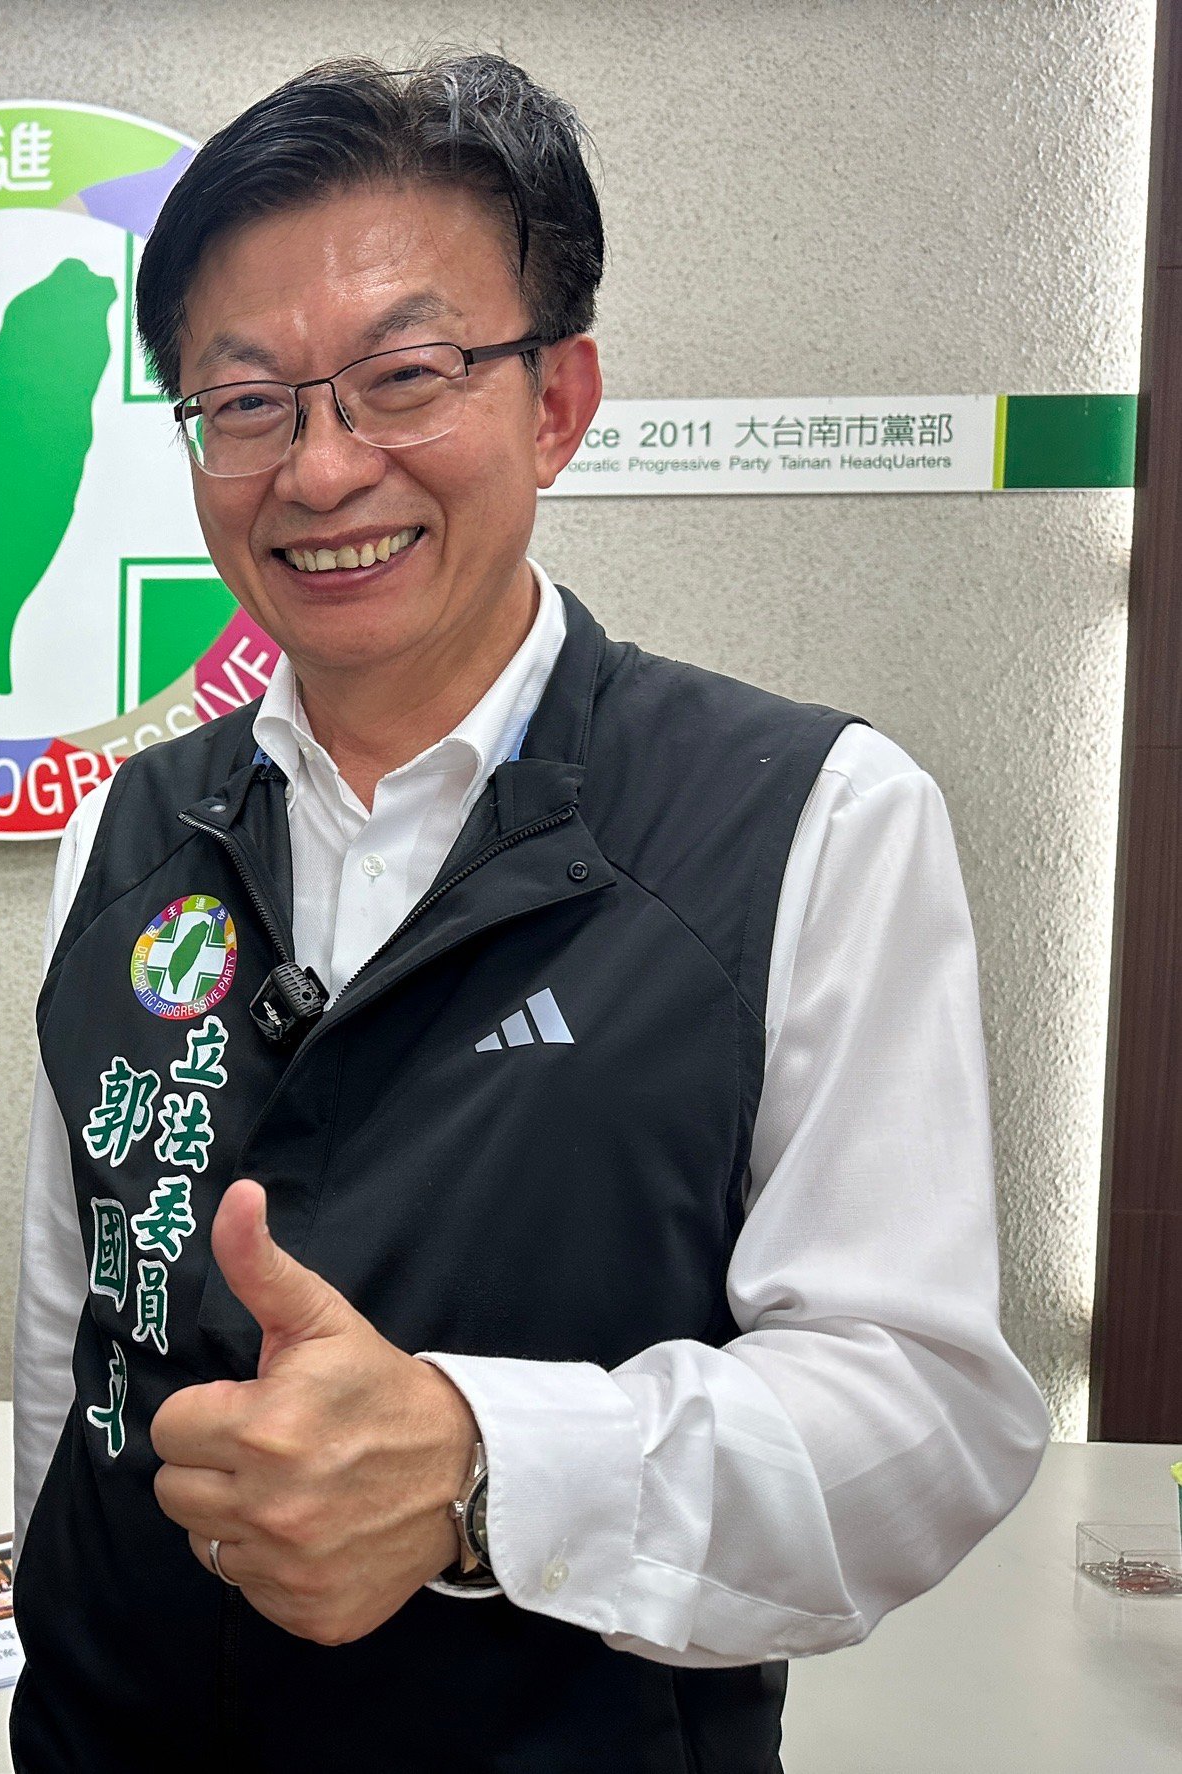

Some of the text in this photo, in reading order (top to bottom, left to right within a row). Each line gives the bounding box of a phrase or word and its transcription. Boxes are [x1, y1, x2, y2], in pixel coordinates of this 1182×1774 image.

[639, 421, 712, 448] 2011
[734, 413, 954, 448] 大台南市黨部
[567, 457, 620, 473] ocratic
[628, 456, 721, 475] Progressive
[729, 455, 771, 474] Party
[779, 454, 831, 471] Tainan
[133, 945, 236, 1018] DEMOCRATIC PROGRESSIVE PARTY
[130, 1015, 228, 1356] 立法委員
